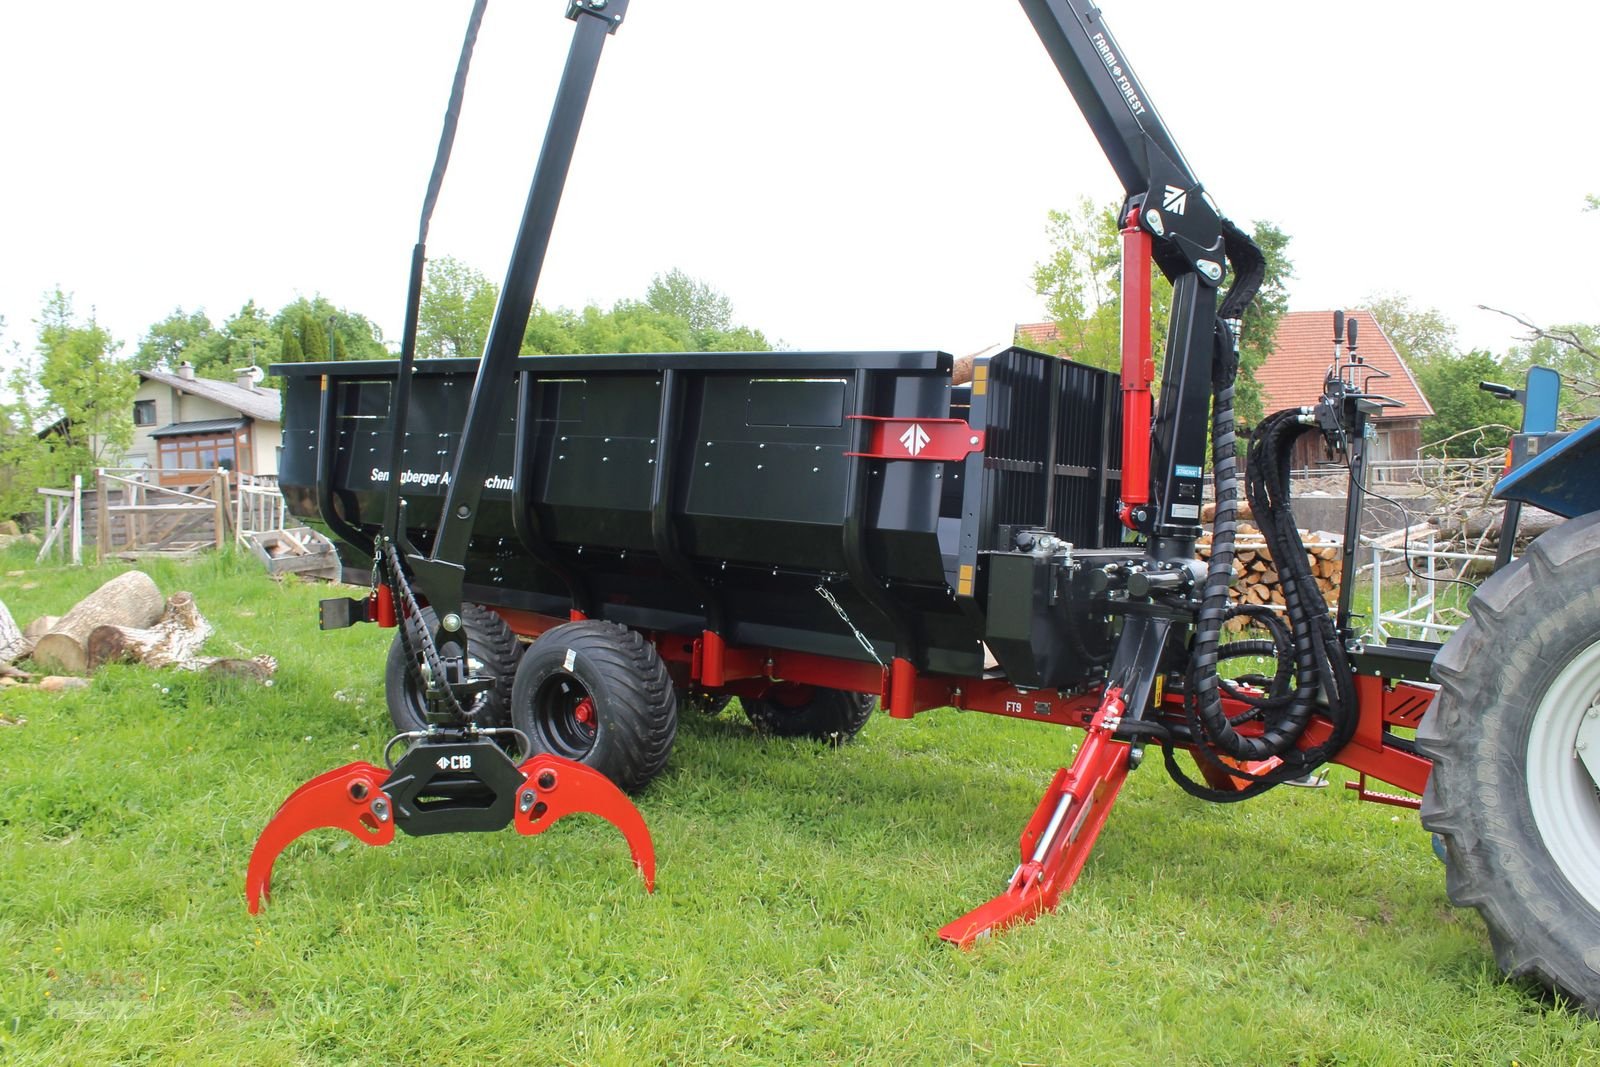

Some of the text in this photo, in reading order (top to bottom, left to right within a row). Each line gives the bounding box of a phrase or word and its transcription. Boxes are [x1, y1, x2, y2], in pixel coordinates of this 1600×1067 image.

[1093, 32, 1146, 115] FARMI FOREST
[1006, 701, 1022, 713] FT9
[450, 754, 472, 770] C18
